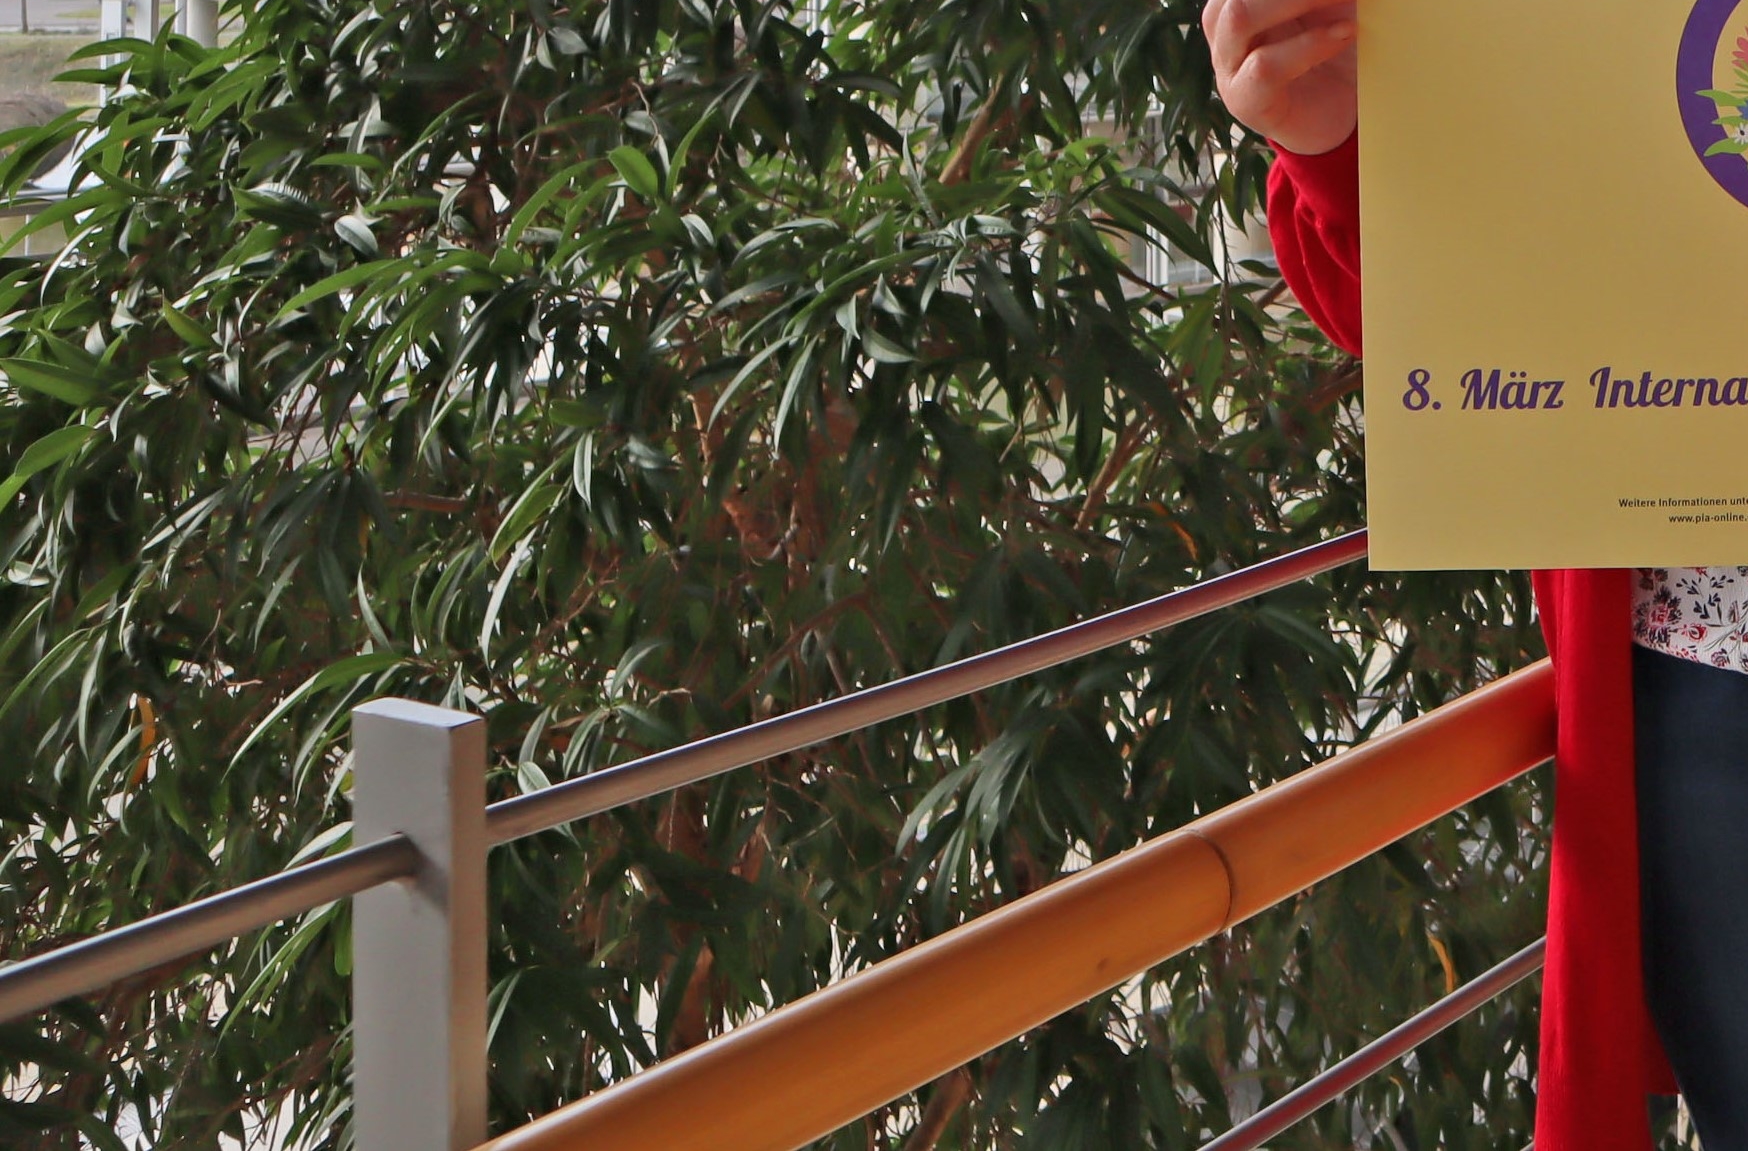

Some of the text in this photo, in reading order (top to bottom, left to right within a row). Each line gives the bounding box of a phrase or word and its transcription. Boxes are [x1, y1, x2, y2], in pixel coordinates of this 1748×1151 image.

[1402, 368, 1442, 411] 8.
[1459, 368, 1566, 411] März
[1618, 497, 1656, 508] Weitere
[1658, 496, 1728, 508] Informationen
